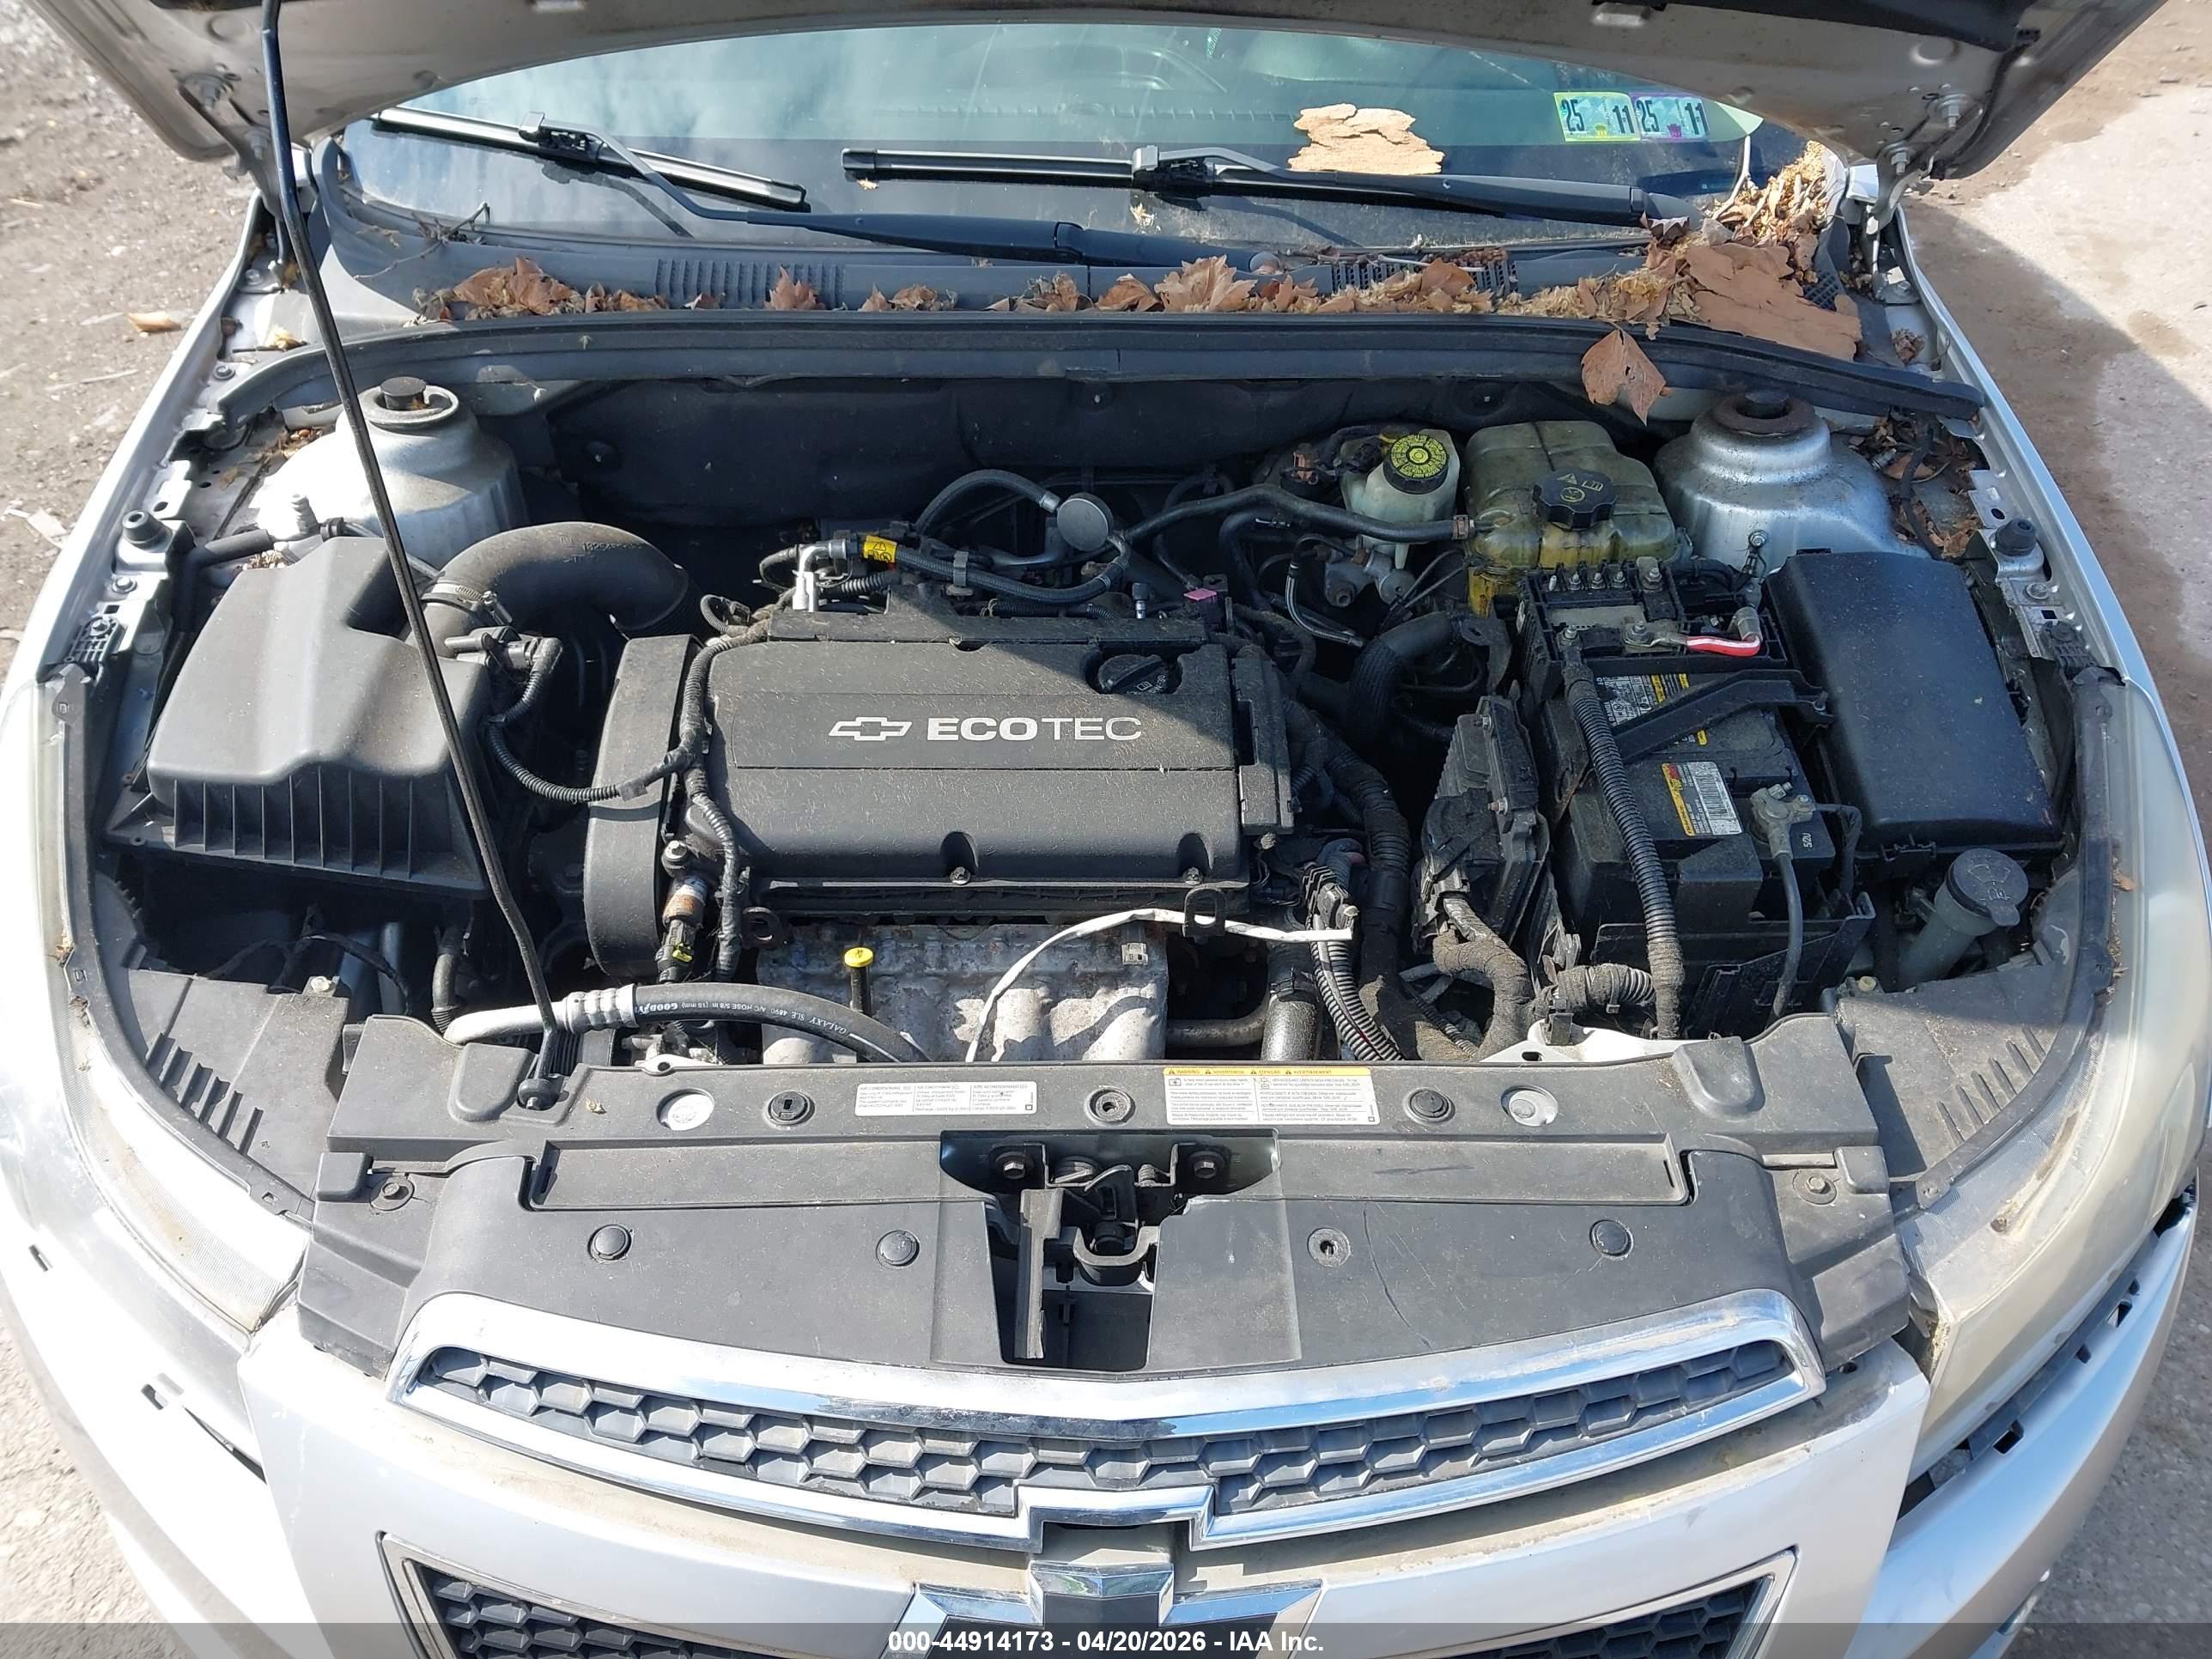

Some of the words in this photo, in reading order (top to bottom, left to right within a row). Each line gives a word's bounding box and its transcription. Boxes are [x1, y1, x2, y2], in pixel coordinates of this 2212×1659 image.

[1561, 99, 1585, 131] 25
[1612, 105, 1635, 134] 11
[1636, 100, 1660, 132] 25
[1684, 102, 1710, 135] 11
[927, 717, 1142, 741] ECOTEC
[732, 1003, 753, 1012] HOSE
[791, 1011, 805, 1021] SLE
[809, 1016, 848, 1035] GALAXY
